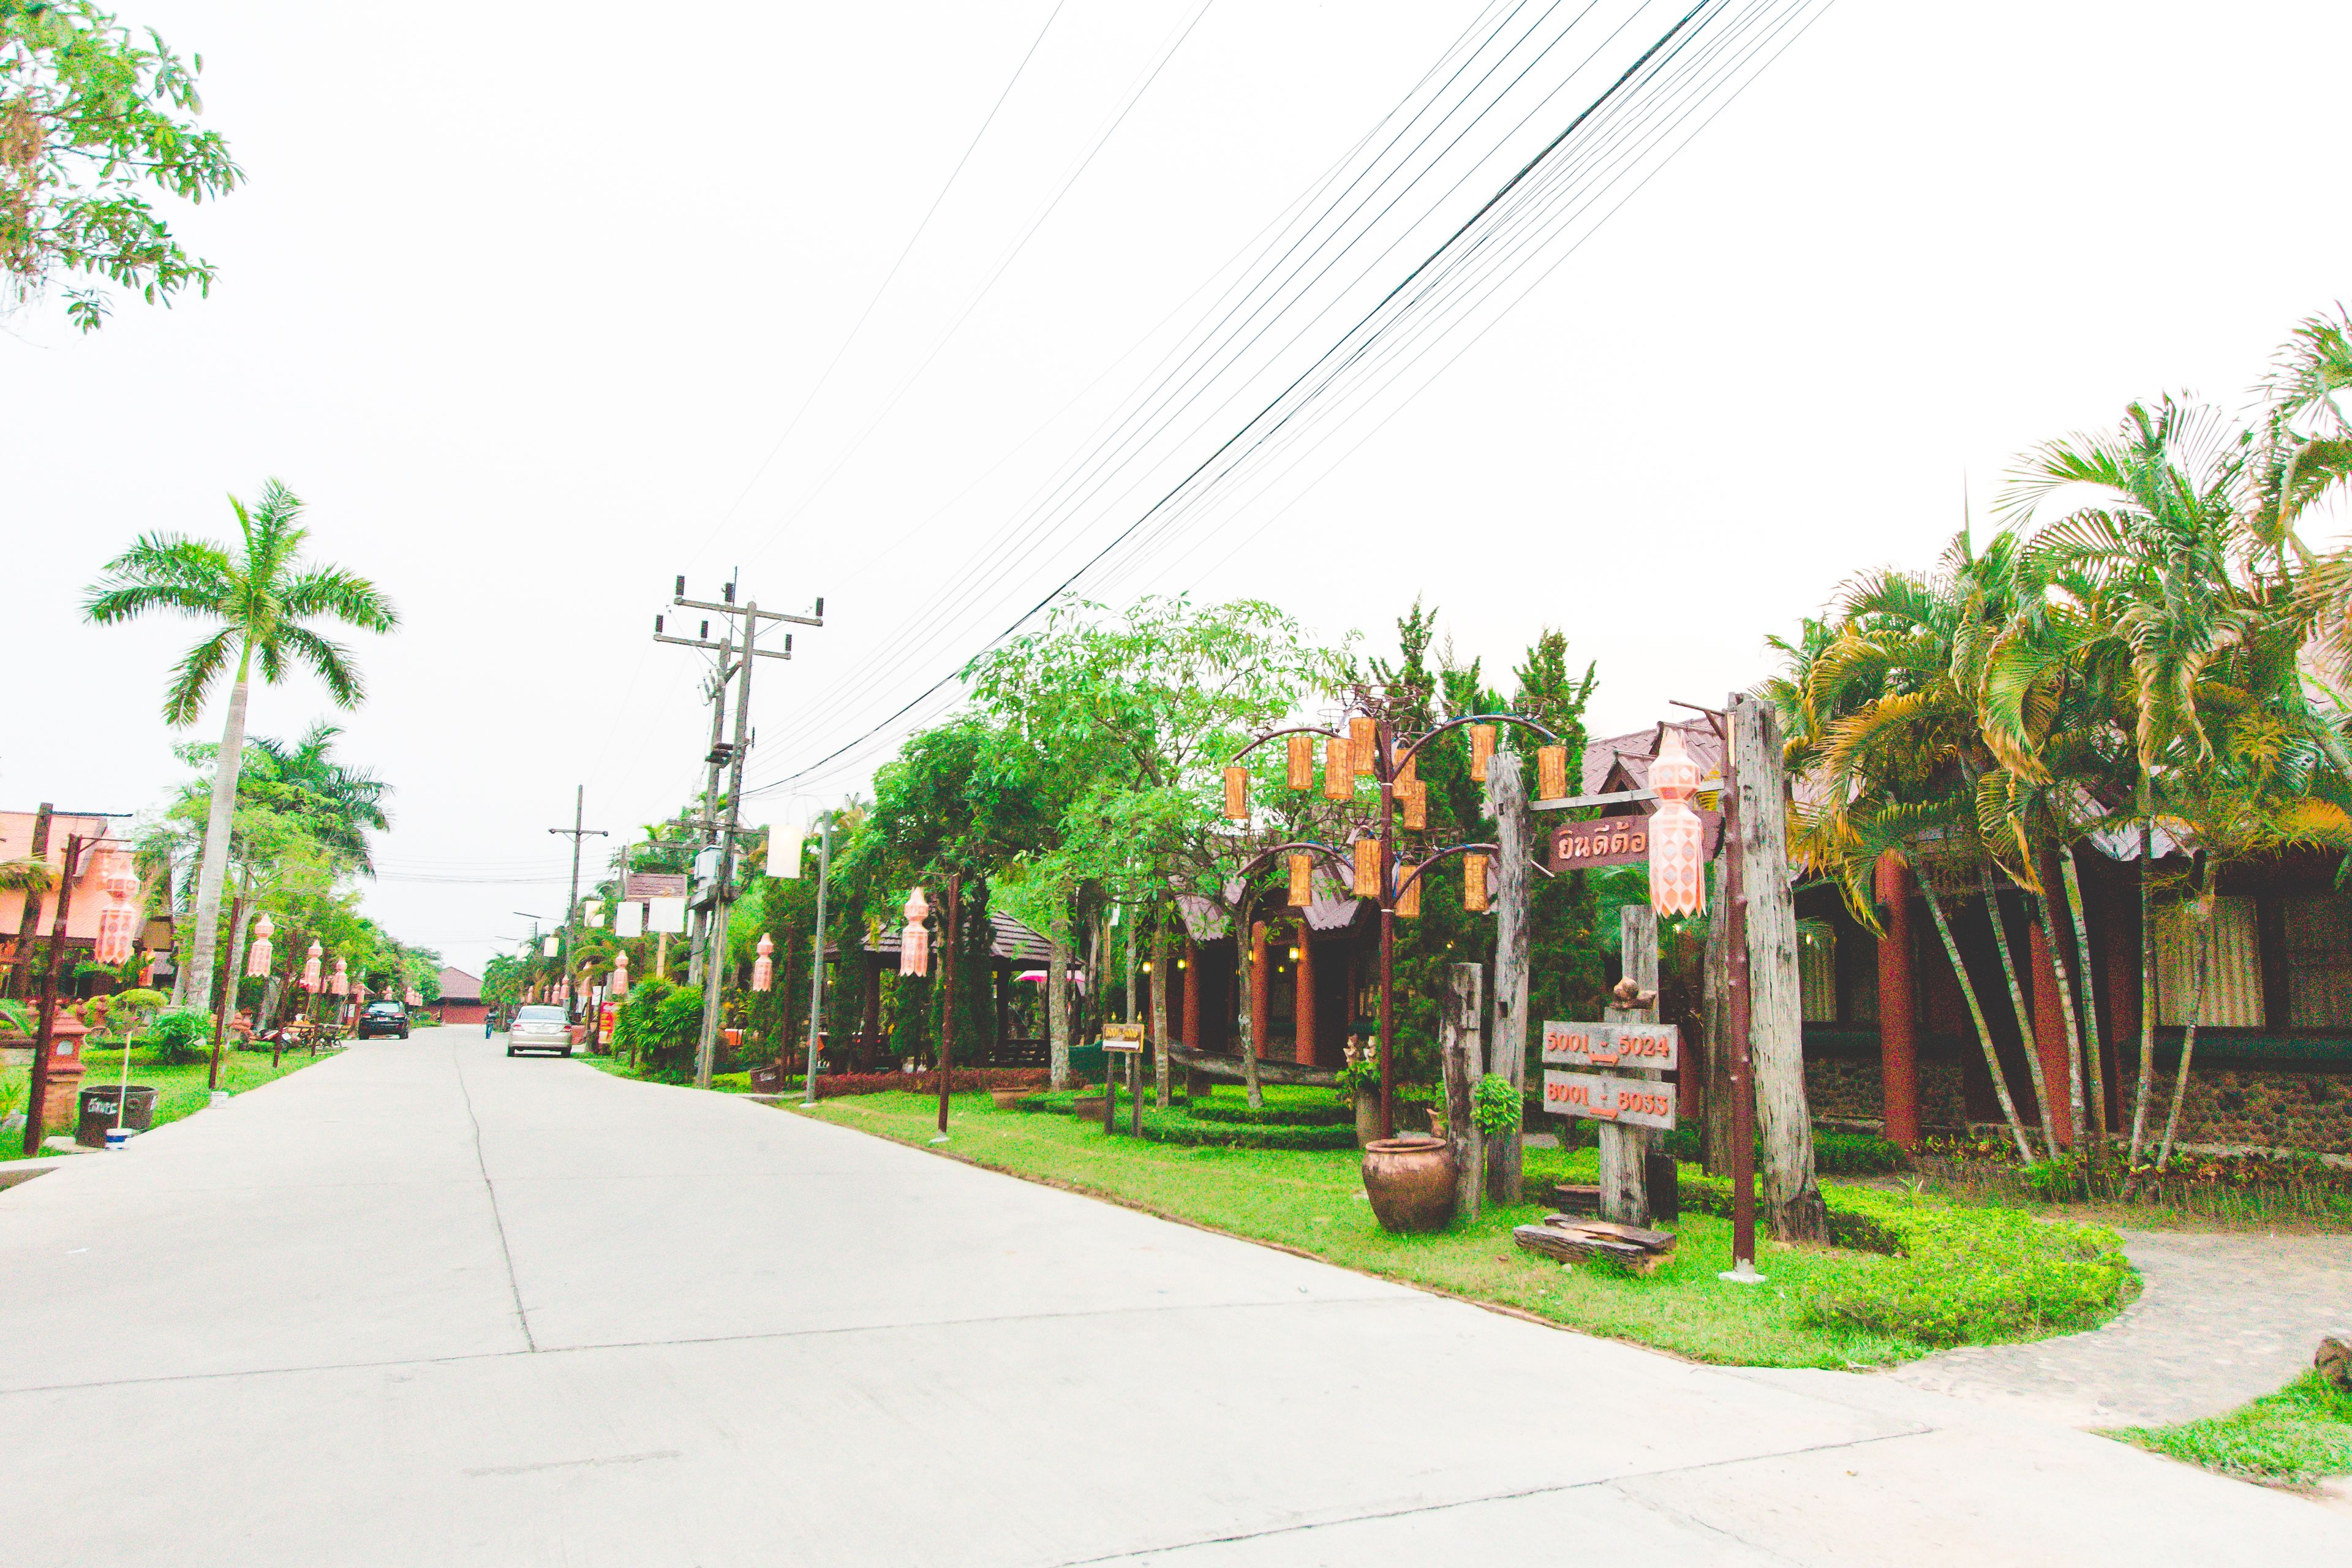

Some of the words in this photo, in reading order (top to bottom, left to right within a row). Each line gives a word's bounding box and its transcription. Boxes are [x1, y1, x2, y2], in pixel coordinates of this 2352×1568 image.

[1558, 821, 1646, 859] ยินดีต้อ
[1547, 1031, 1589, 1054] 5001
[1618, 1034, 1670, 1057] 5024
[1547, 1082, 1589, 1106] 8001
[1618, 1091, 1668, 1116] 8033
